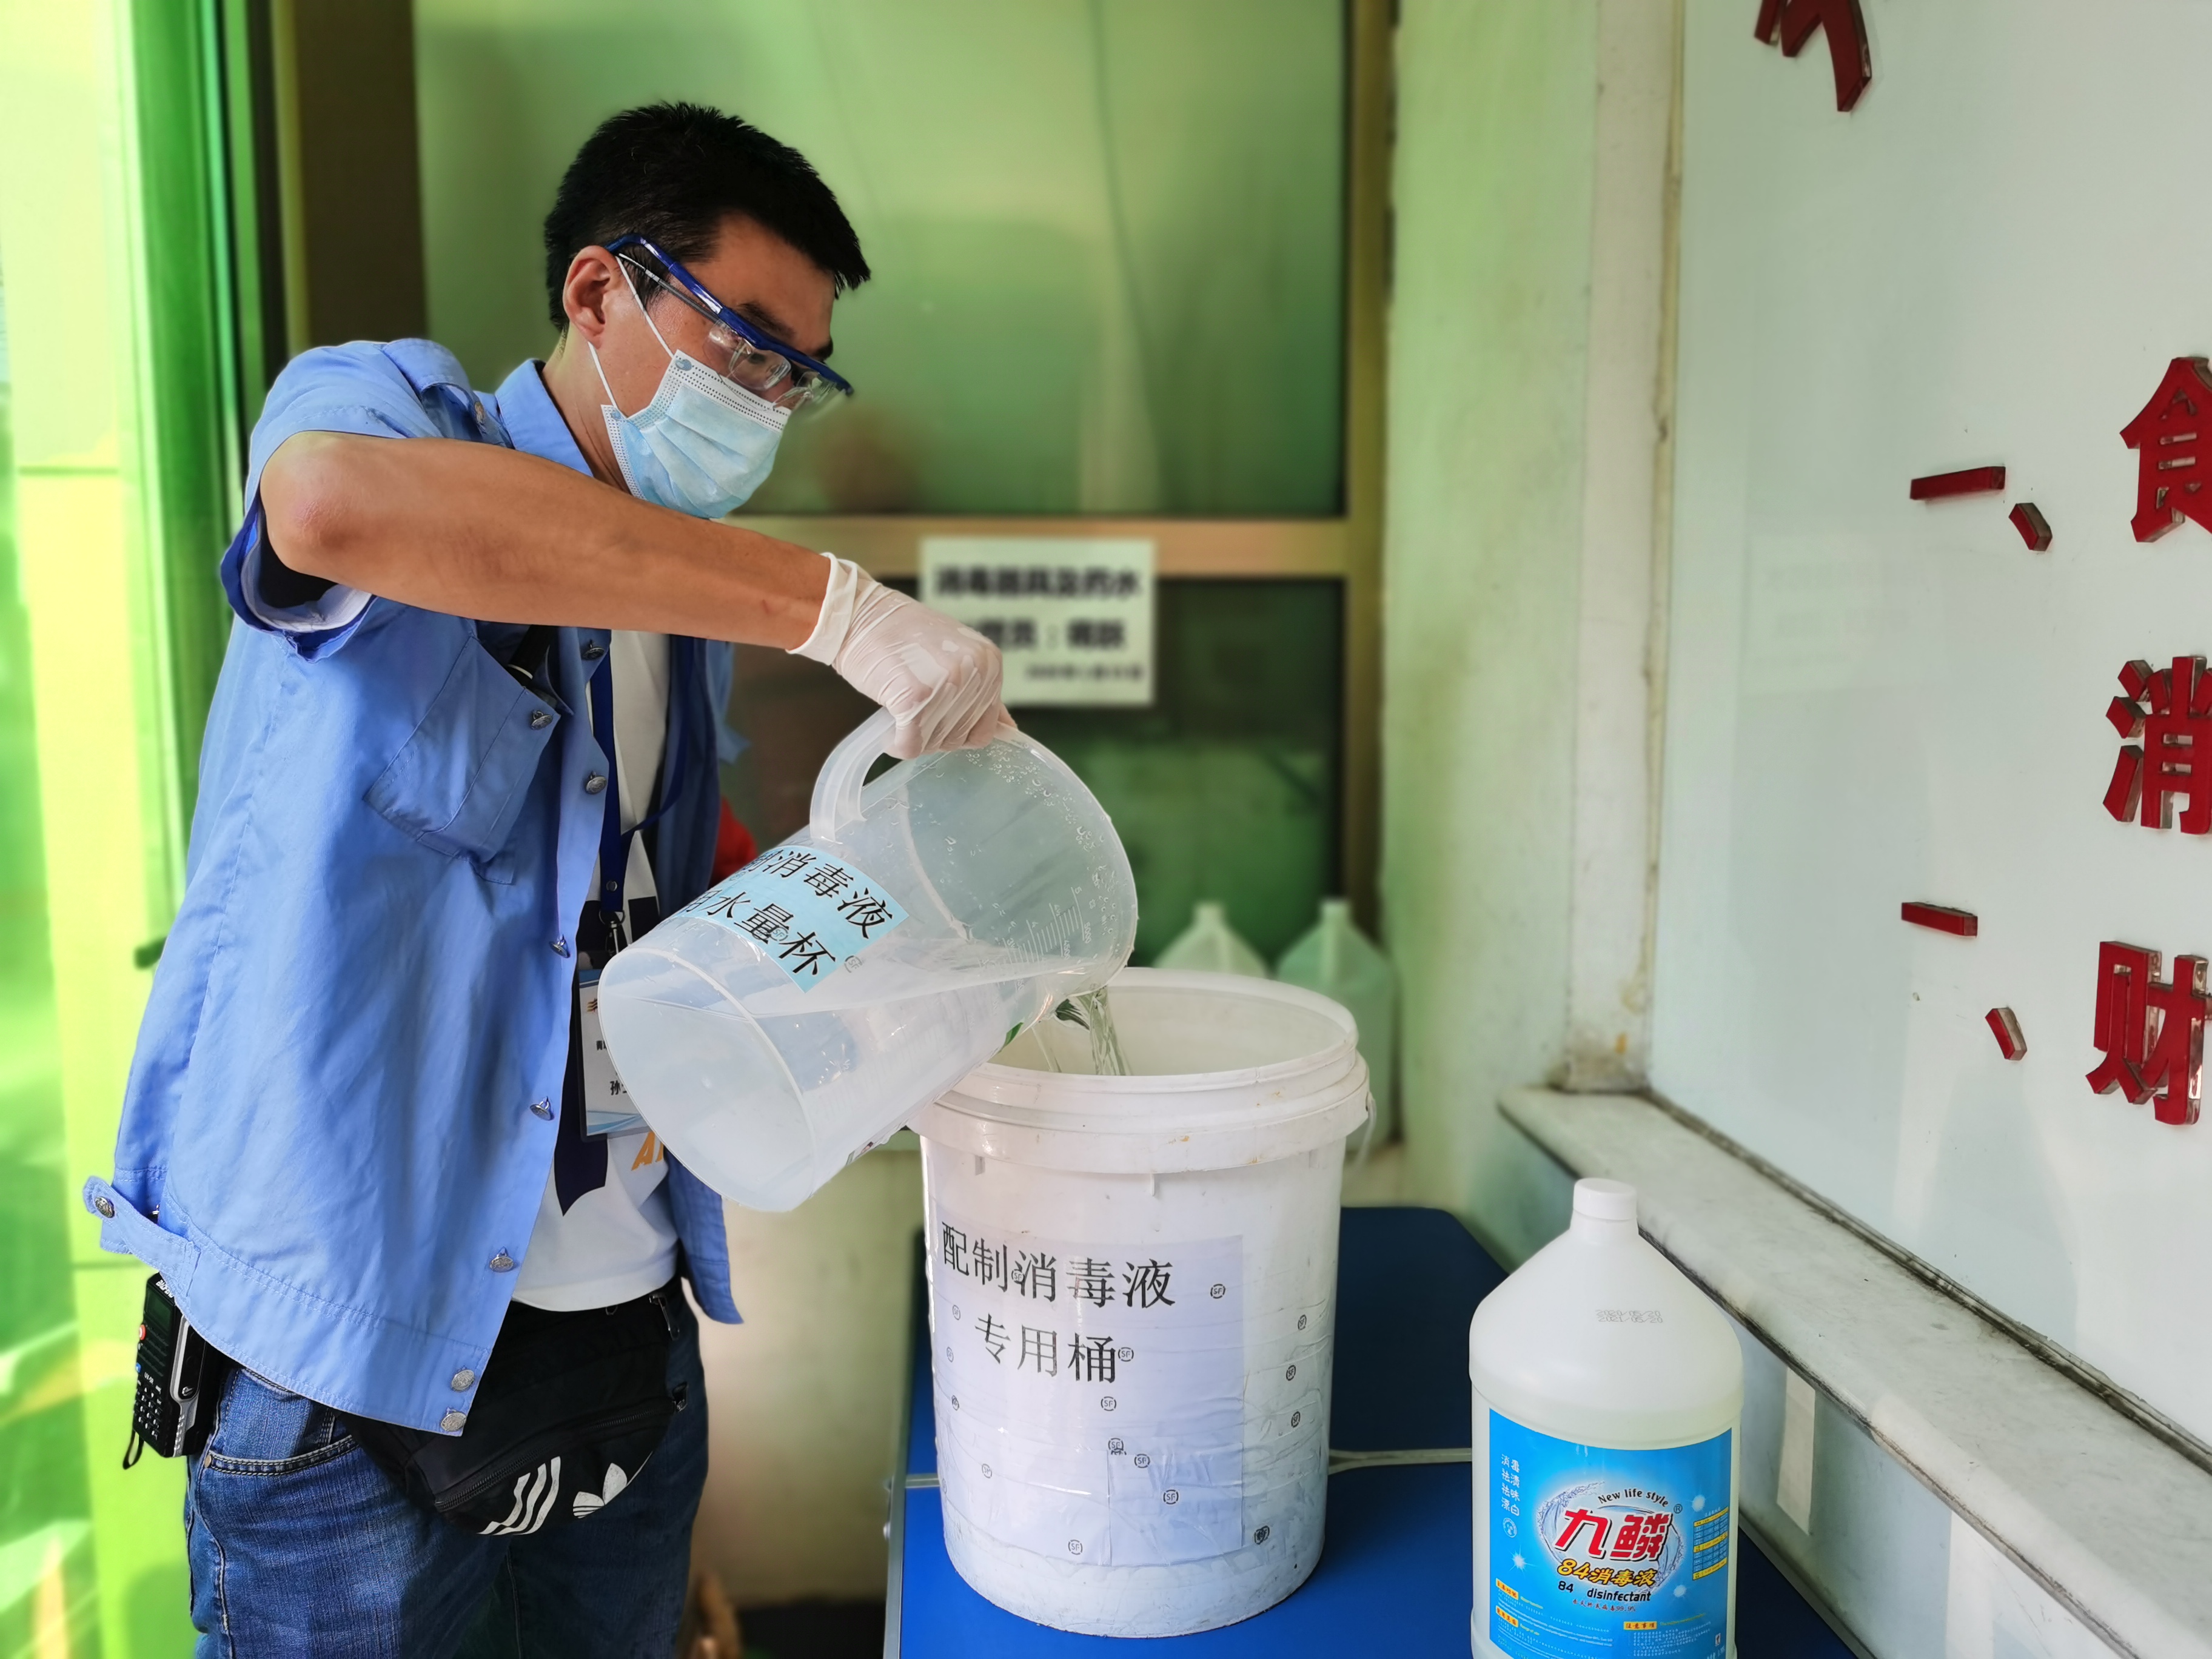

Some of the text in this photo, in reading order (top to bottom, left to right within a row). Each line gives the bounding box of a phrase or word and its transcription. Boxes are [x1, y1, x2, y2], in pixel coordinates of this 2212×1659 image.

[942, 1221, 1175, 1309] 配制消毒液
[974, 1313, 1116, 1383] 专用桶
[1598, 1488, 1669, 1507] New life style
[1554, 1509, 1671, 1560] 九鳞
[1557, 1558, 1658, 1587] 84消毒液
[1558, 1580, 1652, 1601] 84 disinfectant
